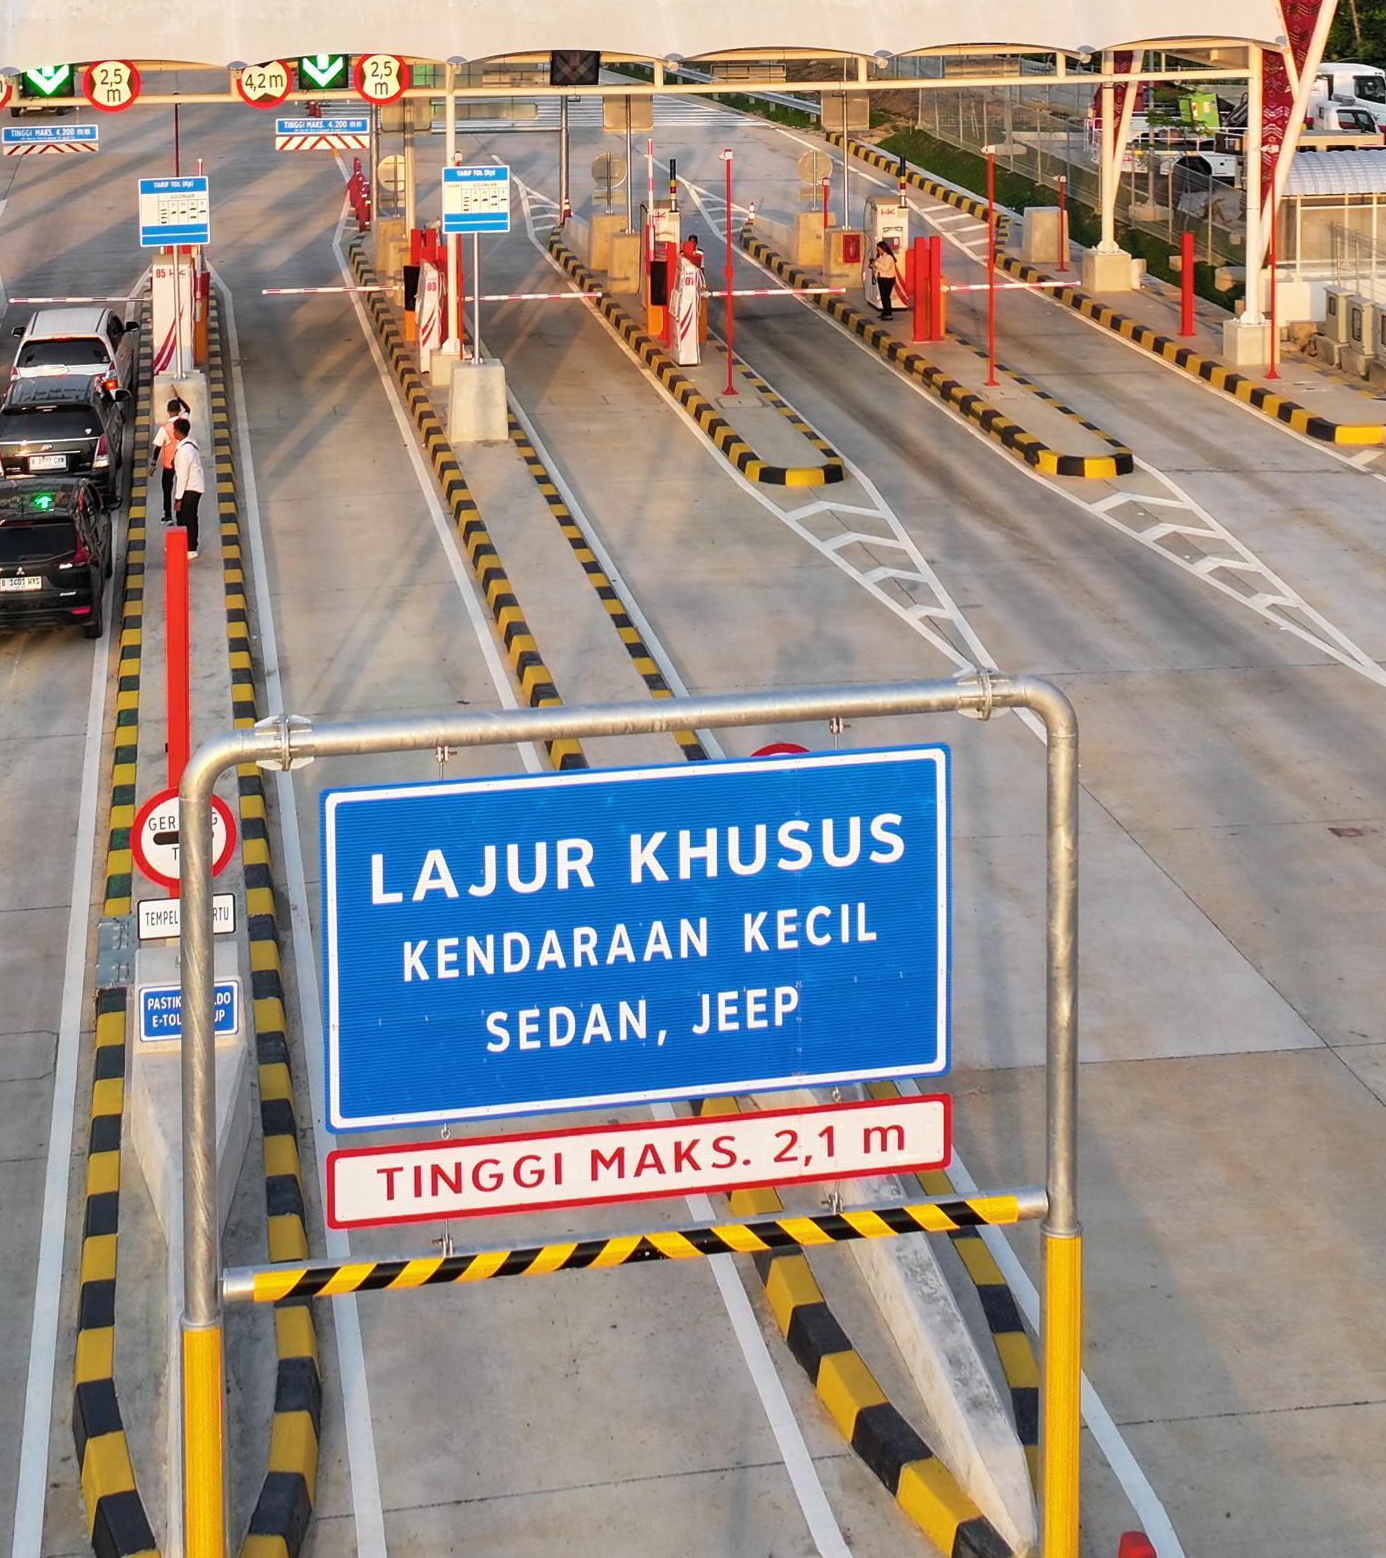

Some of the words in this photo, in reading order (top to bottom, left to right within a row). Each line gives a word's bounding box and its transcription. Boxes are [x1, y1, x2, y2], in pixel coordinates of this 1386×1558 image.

[100, 68, 123, 88] 2,5
[370, 61, 393, 80] 2,5
[106, 88, 121, 102] m
[374, 81, 389, 96] m
[10, 129, 33, 138] TINGGI
[156, 268, 166, 278] 05
[685, 276, 694, 286] 01
[148, 811, 218, 831] GERG
[370, 837, 595, 905] LAJUR
[630, 812, 905, 884] KHUSUS
[145, 910, 179, 927] TEMPEL
[402, 916, 708, 983] KENDARAAN
[743, 902, 877, 954] KECIL
[147, 995, 182, 1010] PASTIK
[485, 998, 667, 1053] SEDAN,
[691, 985, 800, 1035] JEEP
[376, 1151, 562, 1201] TINGGI
[589, 1134, 752, 1182] MAKS.
[772, 1124, 836, 1168] 2,1
[863, 1123, 905, 1155] m
